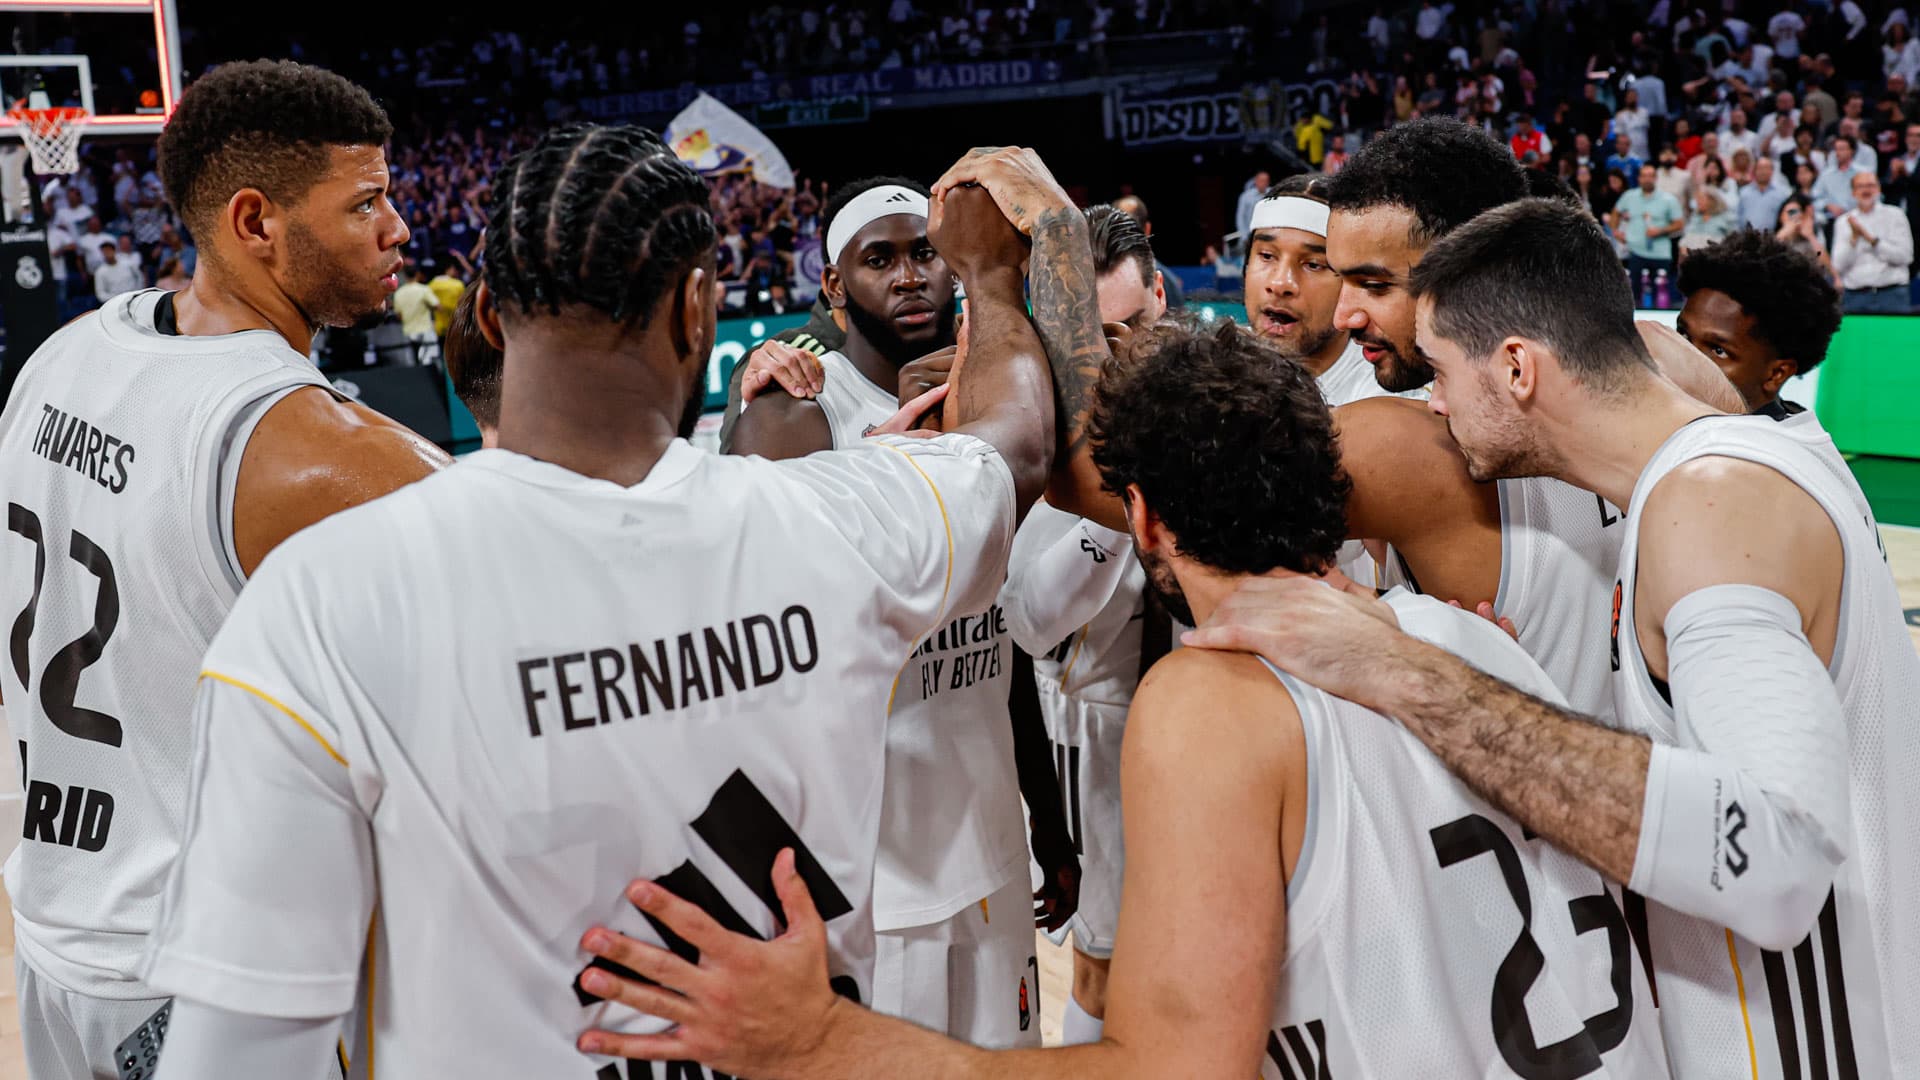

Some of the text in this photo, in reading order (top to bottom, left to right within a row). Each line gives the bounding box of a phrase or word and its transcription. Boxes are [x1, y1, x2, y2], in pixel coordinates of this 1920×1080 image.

[810, 72, 893, 97] REAL
[912, 59, 1033, 90] MADRID
[1124, 97, 1241, 142] DESDE
[32, 403, 135, 494] TAVARES
[516, 604, 819, 738] FERNANDO
[20, 766, 114, 853] RID
